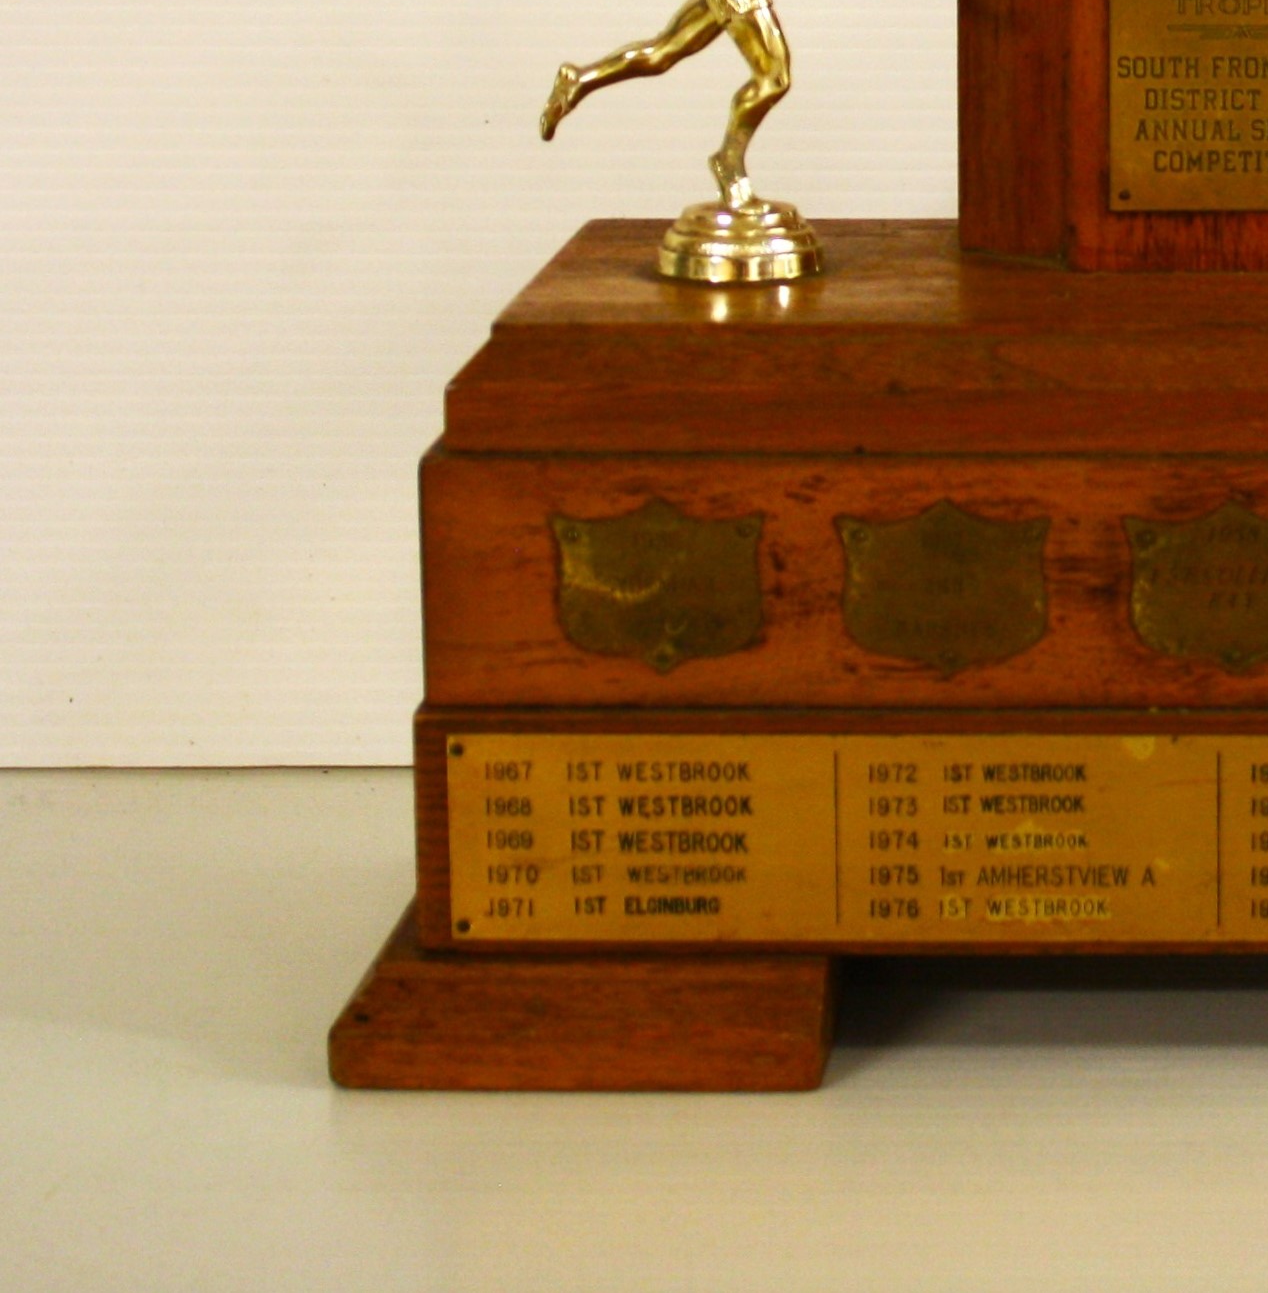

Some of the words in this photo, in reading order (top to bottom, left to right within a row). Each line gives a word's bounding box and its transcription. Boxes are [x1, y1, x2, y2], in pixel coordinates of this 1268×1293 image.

[1117, 56, 1198, 79] SOUTH
[1144, 88, 1261, 110] DISTRICT
[1134, 119, 1241, 141] ANNUAL
[485, 762, 533, 782] 1967
[617, 762, 749, 782] WESTBROOK
[868, 764, 918, 783] 1972
[982, 764, 1087, 783] WESTBROOK
[485, 797, 533, 816] 1968
[619, 795, 752, 818] WESTBROOK
[868, 798, 918, 816] 1973
[980, 796, 1085, 813] WESTBROOK
[486, 830, 534, 849] 1969
[618, 831, 748, 854] WESTBROOK
[869, 831, 920, 849] 1974
[985, 834, 1088, 849] WESTBROOK
[487, 865, 539, 883] 1970
[627, 865, 746, 883] WESTBROOK
[870, 867, 920, 885] 1975
[977, 867, 1128, 887] AMHERSTVIEW
[1142, 868, 1156, 886] A
[485, 899, 534, 917] 1971
[869, 900, 920, 918] 1976
[988, 899, 1107, 916] WESTBROOK
